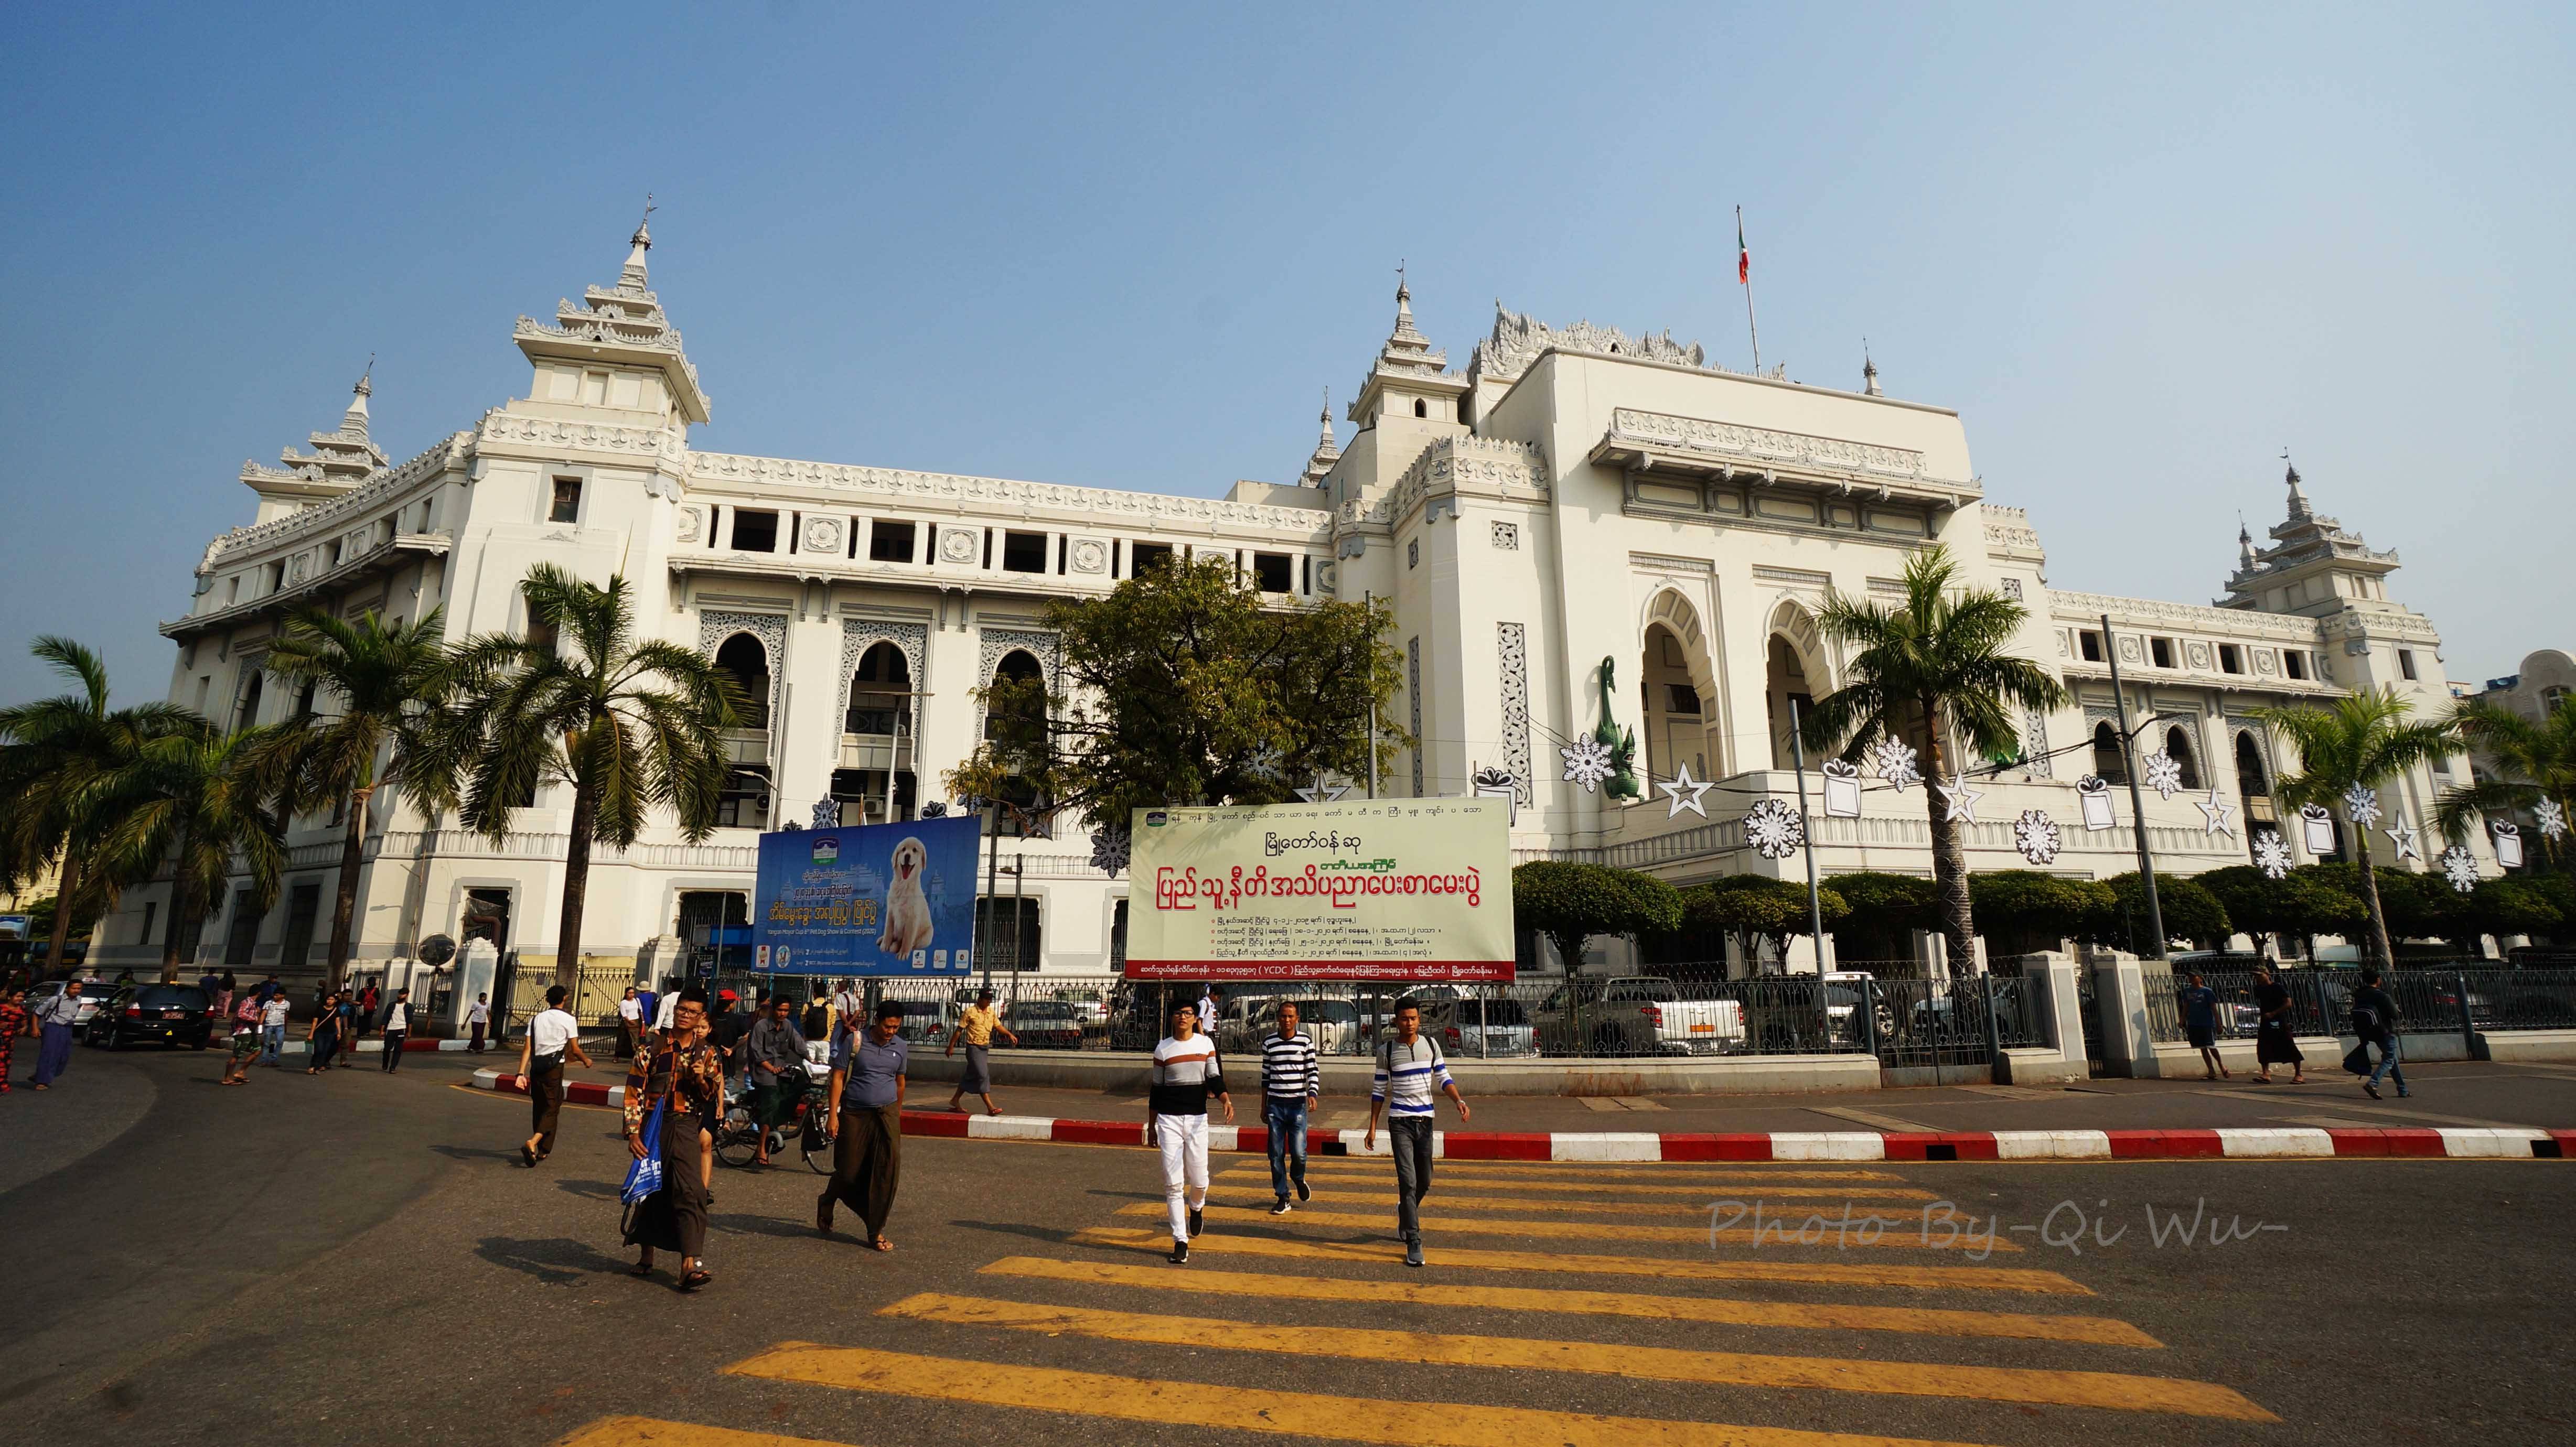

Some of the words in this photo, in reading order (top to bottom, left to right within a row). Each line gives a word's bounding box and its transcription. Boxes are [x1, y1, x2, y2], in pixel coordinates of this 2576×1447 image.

[1265, 830, 1339, 857] မြို့တော်ဝန်
[1343, 836, 1361, 855] ဆု
